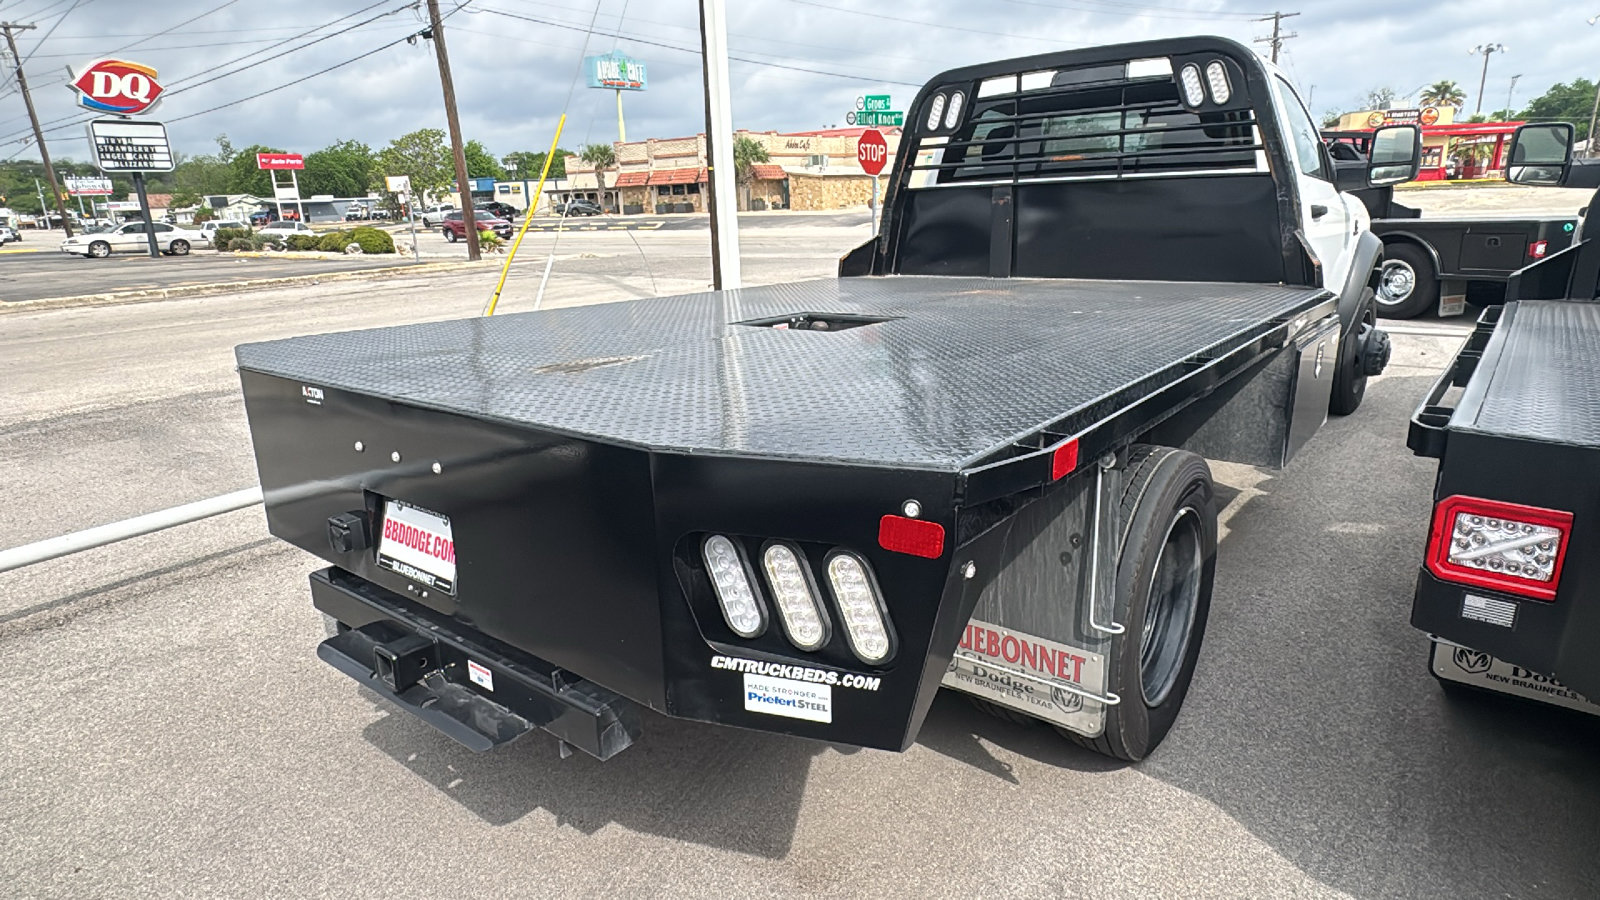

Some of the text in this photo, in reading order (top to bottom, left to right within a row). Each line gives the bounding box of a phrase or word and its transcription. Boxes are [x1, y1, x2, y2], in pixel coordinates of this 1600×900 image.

[91, 71, 150, 103] DQ
[878, 113, 895, 125] Knox
[113, 160, 155, 168] BLIZZARD
[860, 143, 886, 162] STOP
[384, 518, 456, 564] BBDODGE.COM
[392, 561, 436, 586] BLUEBONNET
[710, 655, 881, 691] CMTRUCKBEDS.COM
[972, 664, 1035, 694] Dodge
[747, 683, 770, 693] MADE
[772, 687, 817, 699] STRONGER
[955, 671, 1053, 710] NEW BRAUNFELS, TEXAS
[1485, 672, 1511, 684] NEW
[1512, 679, 1580, 702] BRAUNFELS,
[797, 699, 829, 713] STEEL
